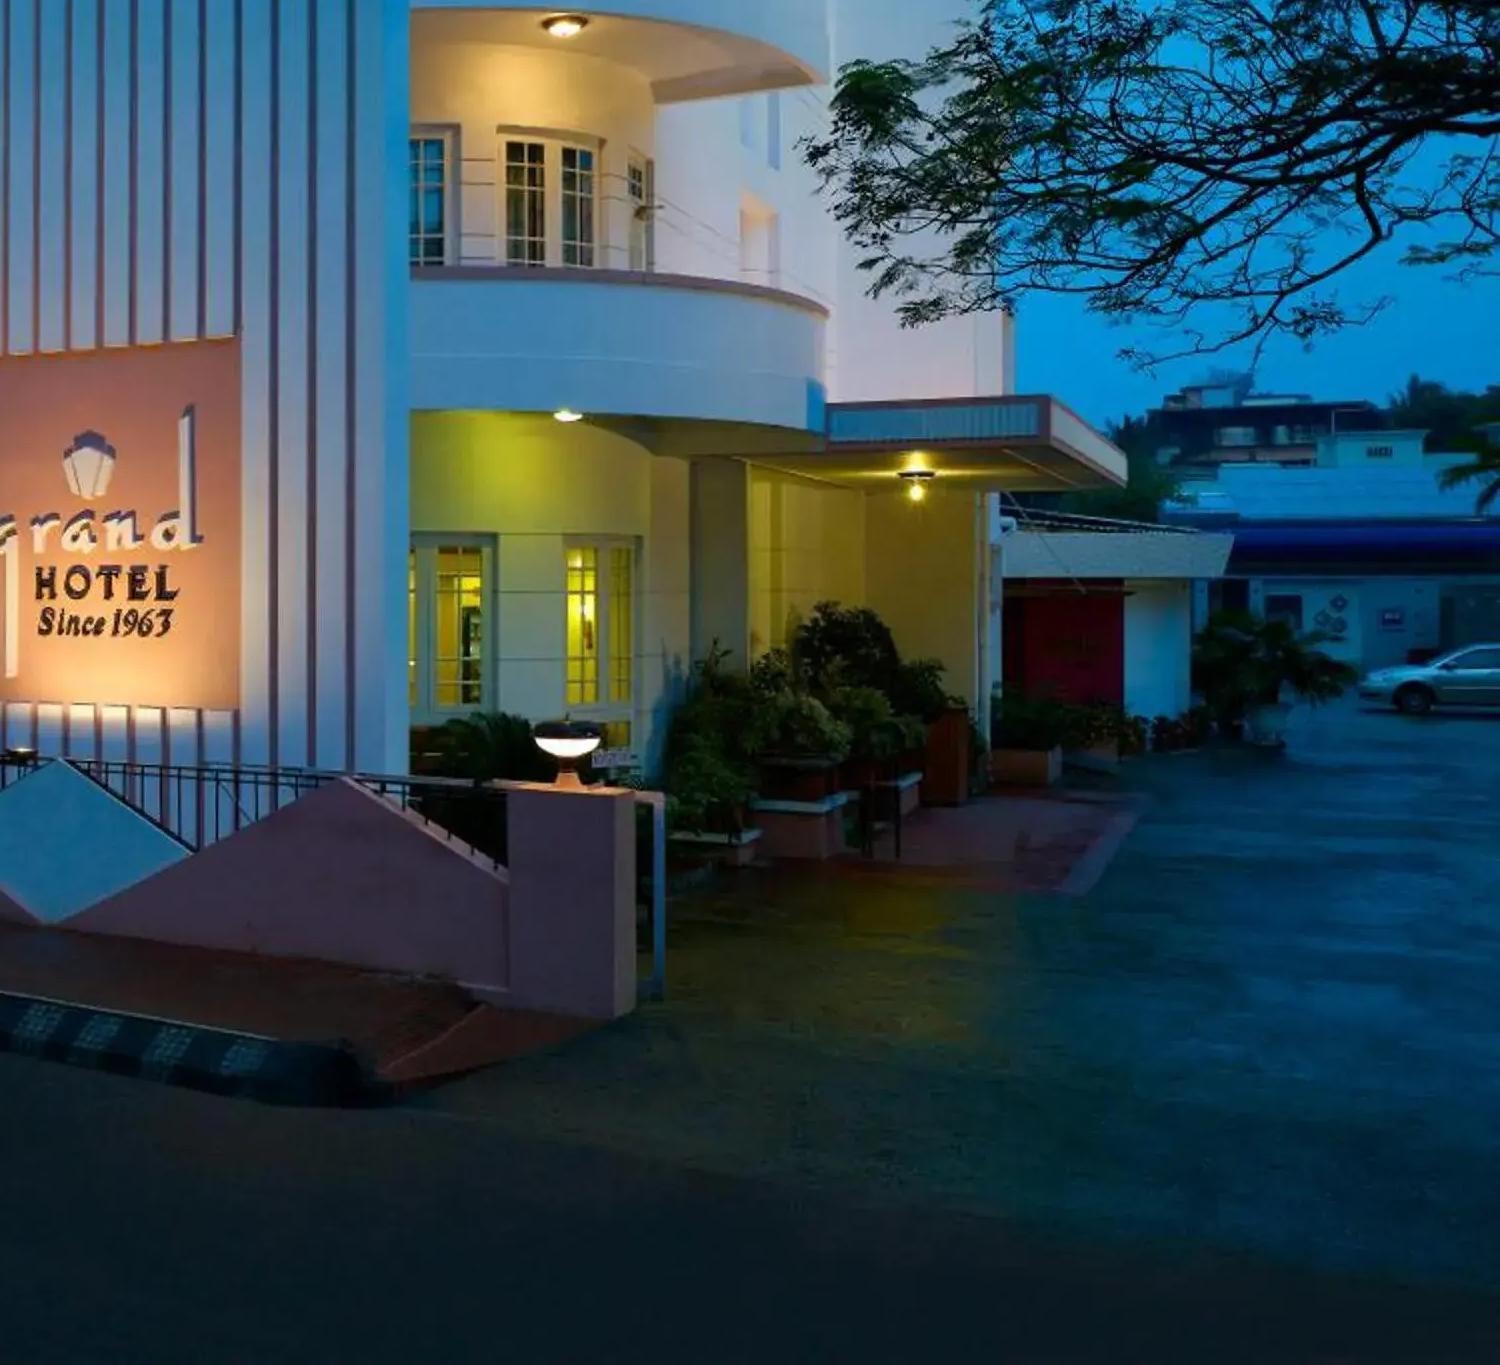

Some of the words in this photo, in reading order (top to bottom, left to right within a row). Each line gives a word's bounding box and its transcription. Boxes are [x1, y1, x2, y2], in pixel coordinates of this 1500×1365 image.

[35, 565, 180, 600] HOTEL
[38, 606, 106, 637] Since
[111, 607, 174, 637] 1963
